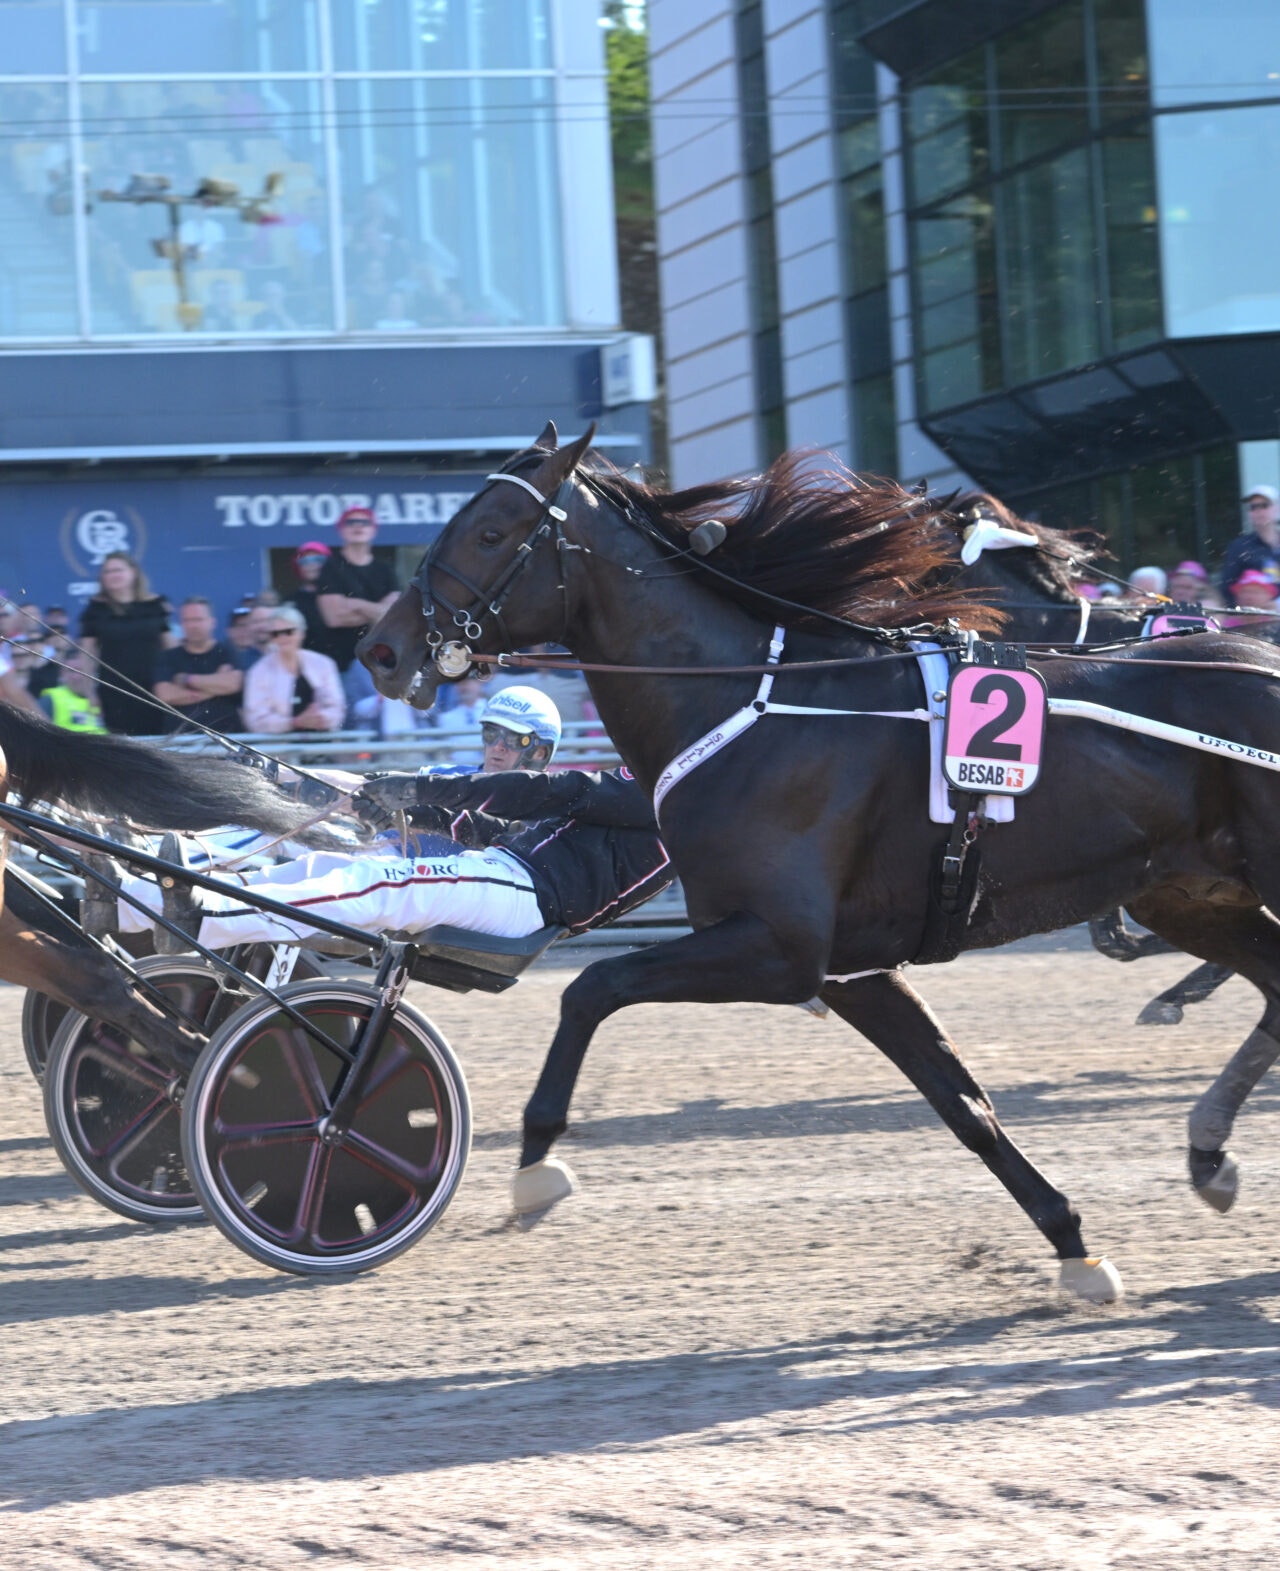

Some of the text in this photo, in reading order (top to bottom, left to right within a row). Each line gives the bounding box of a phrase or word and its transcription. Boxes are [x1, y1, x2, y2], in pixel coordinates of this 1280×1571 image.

[965, 673, 1026, 761] 2
[677, 732, 724, 769] STALL
[958, 762, 1005, 786] BESAB
